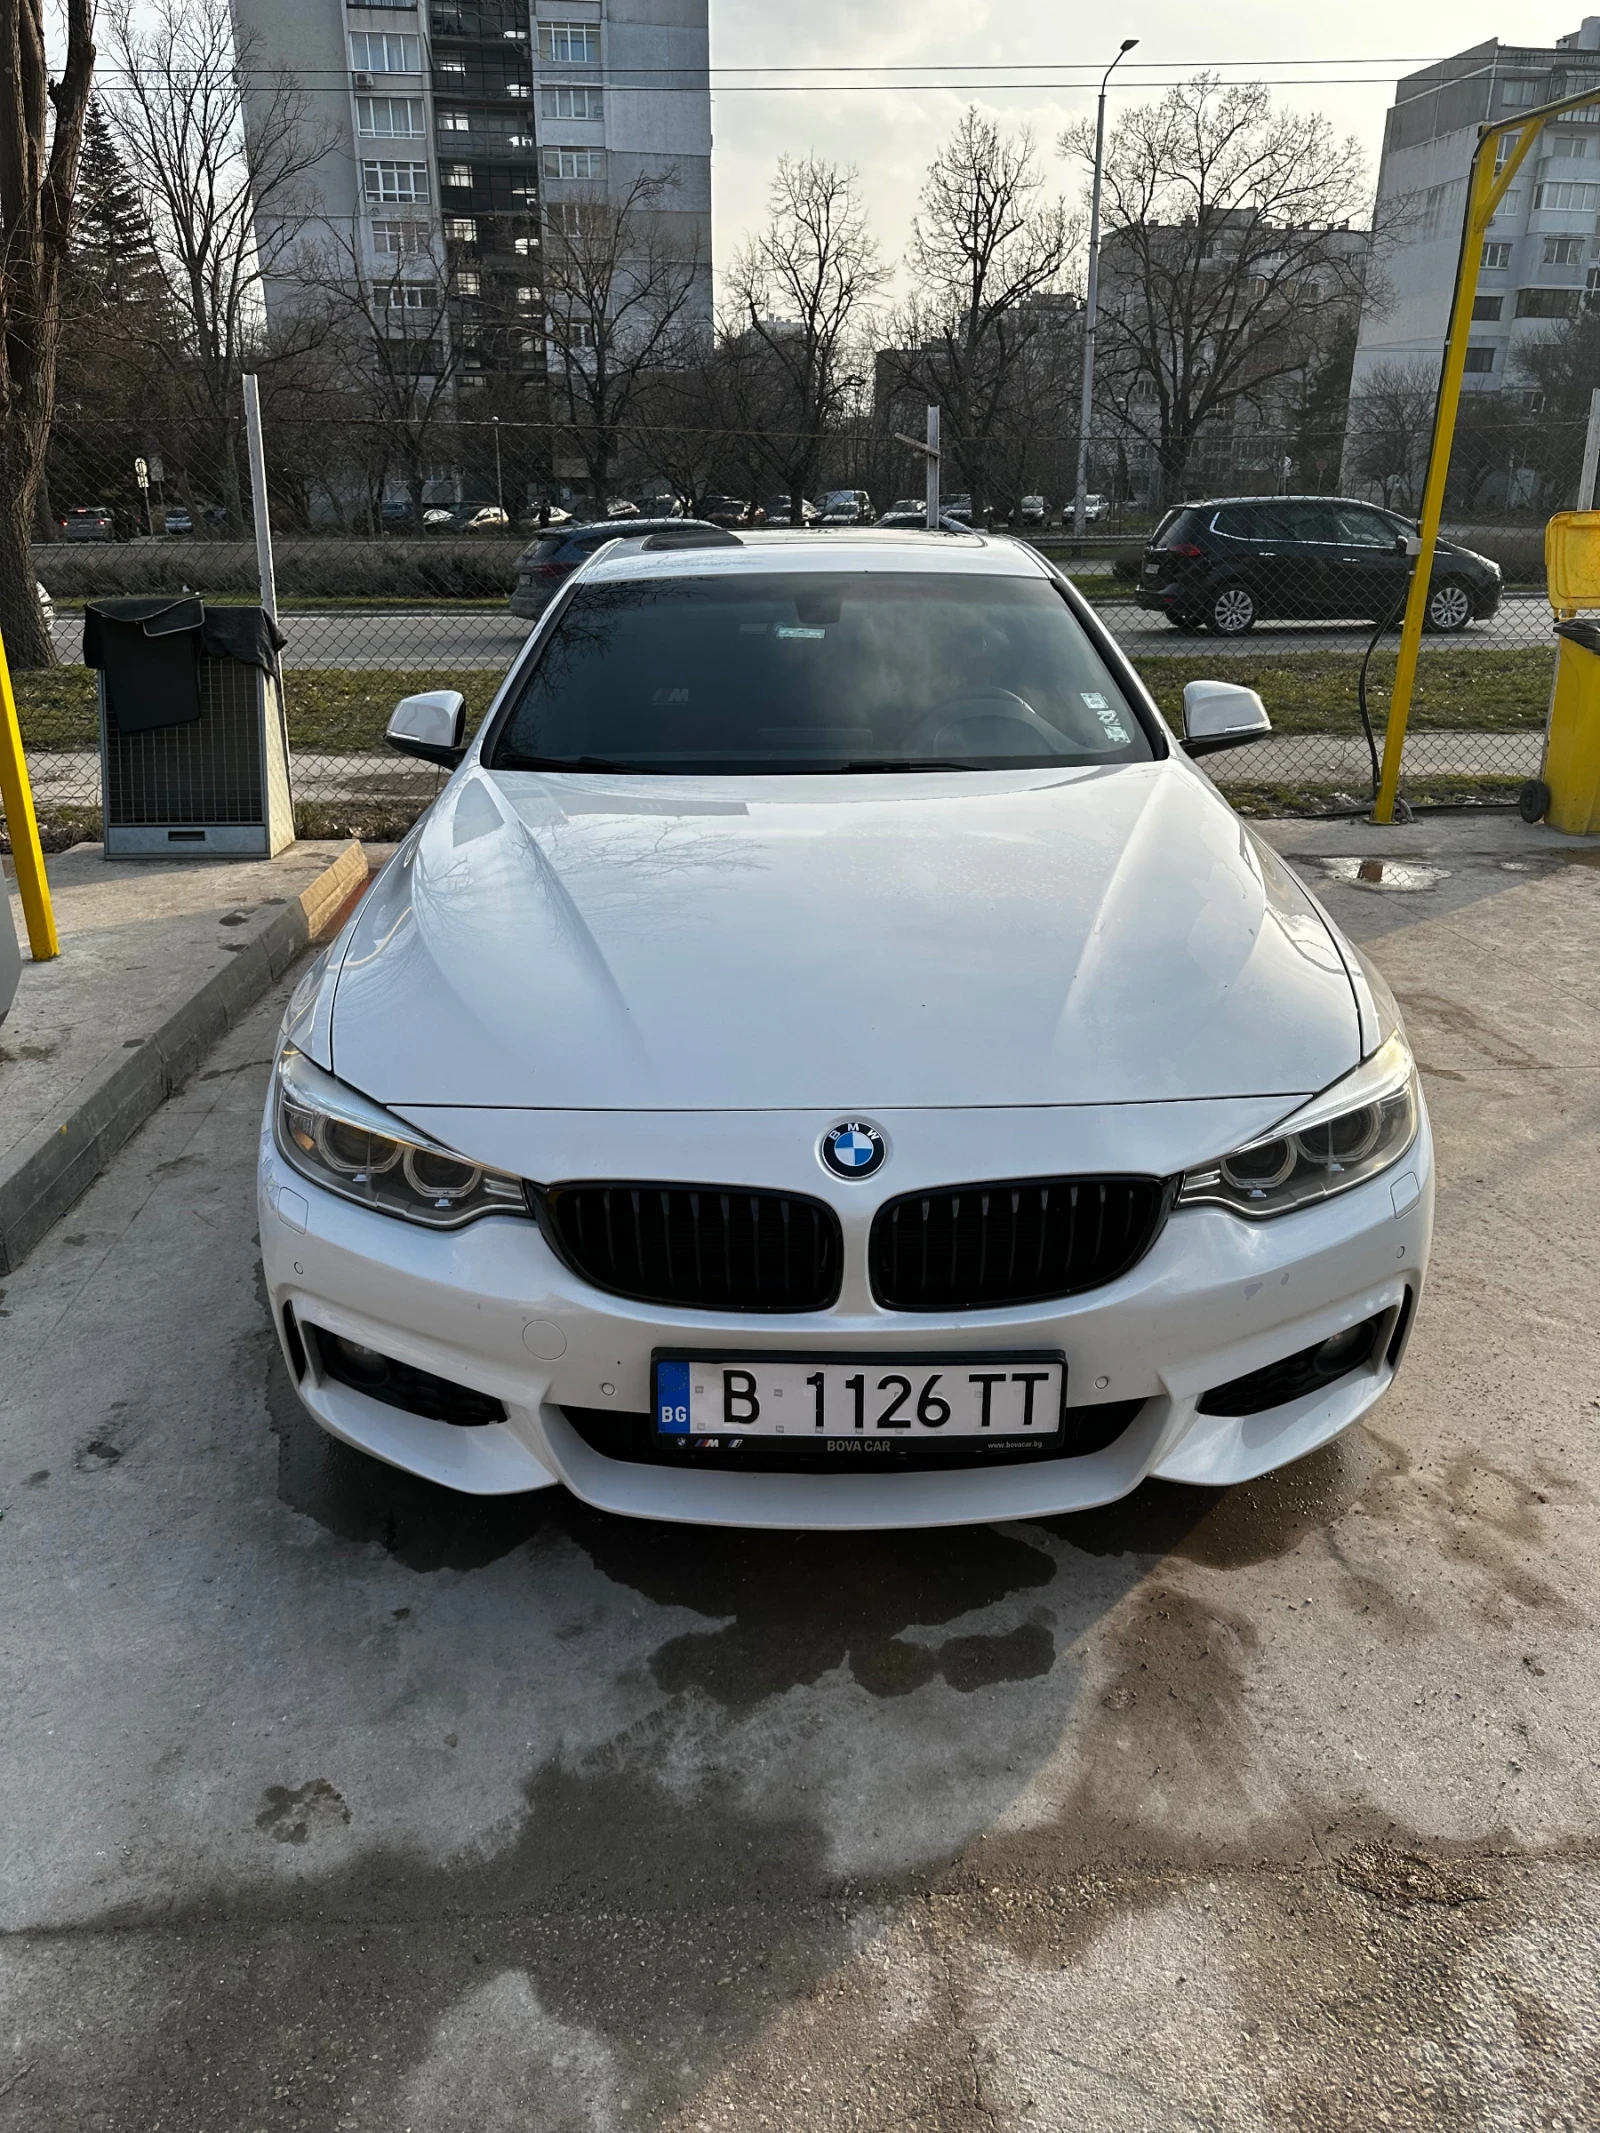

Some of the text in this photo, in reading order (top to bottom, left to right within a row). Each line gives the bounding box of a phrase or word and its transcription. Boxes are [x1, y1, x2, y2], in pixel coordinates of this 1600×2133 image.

[829, 1123, 880, 1140] BMW
[723, 1369, 1049, 1428] B 1126 TT
[661, 1406, 687, 1423] BG
[827, 1440, 891, 1452] BOVA CAR
[987, 1440, 1043, 1449] www.bovacar.bg
